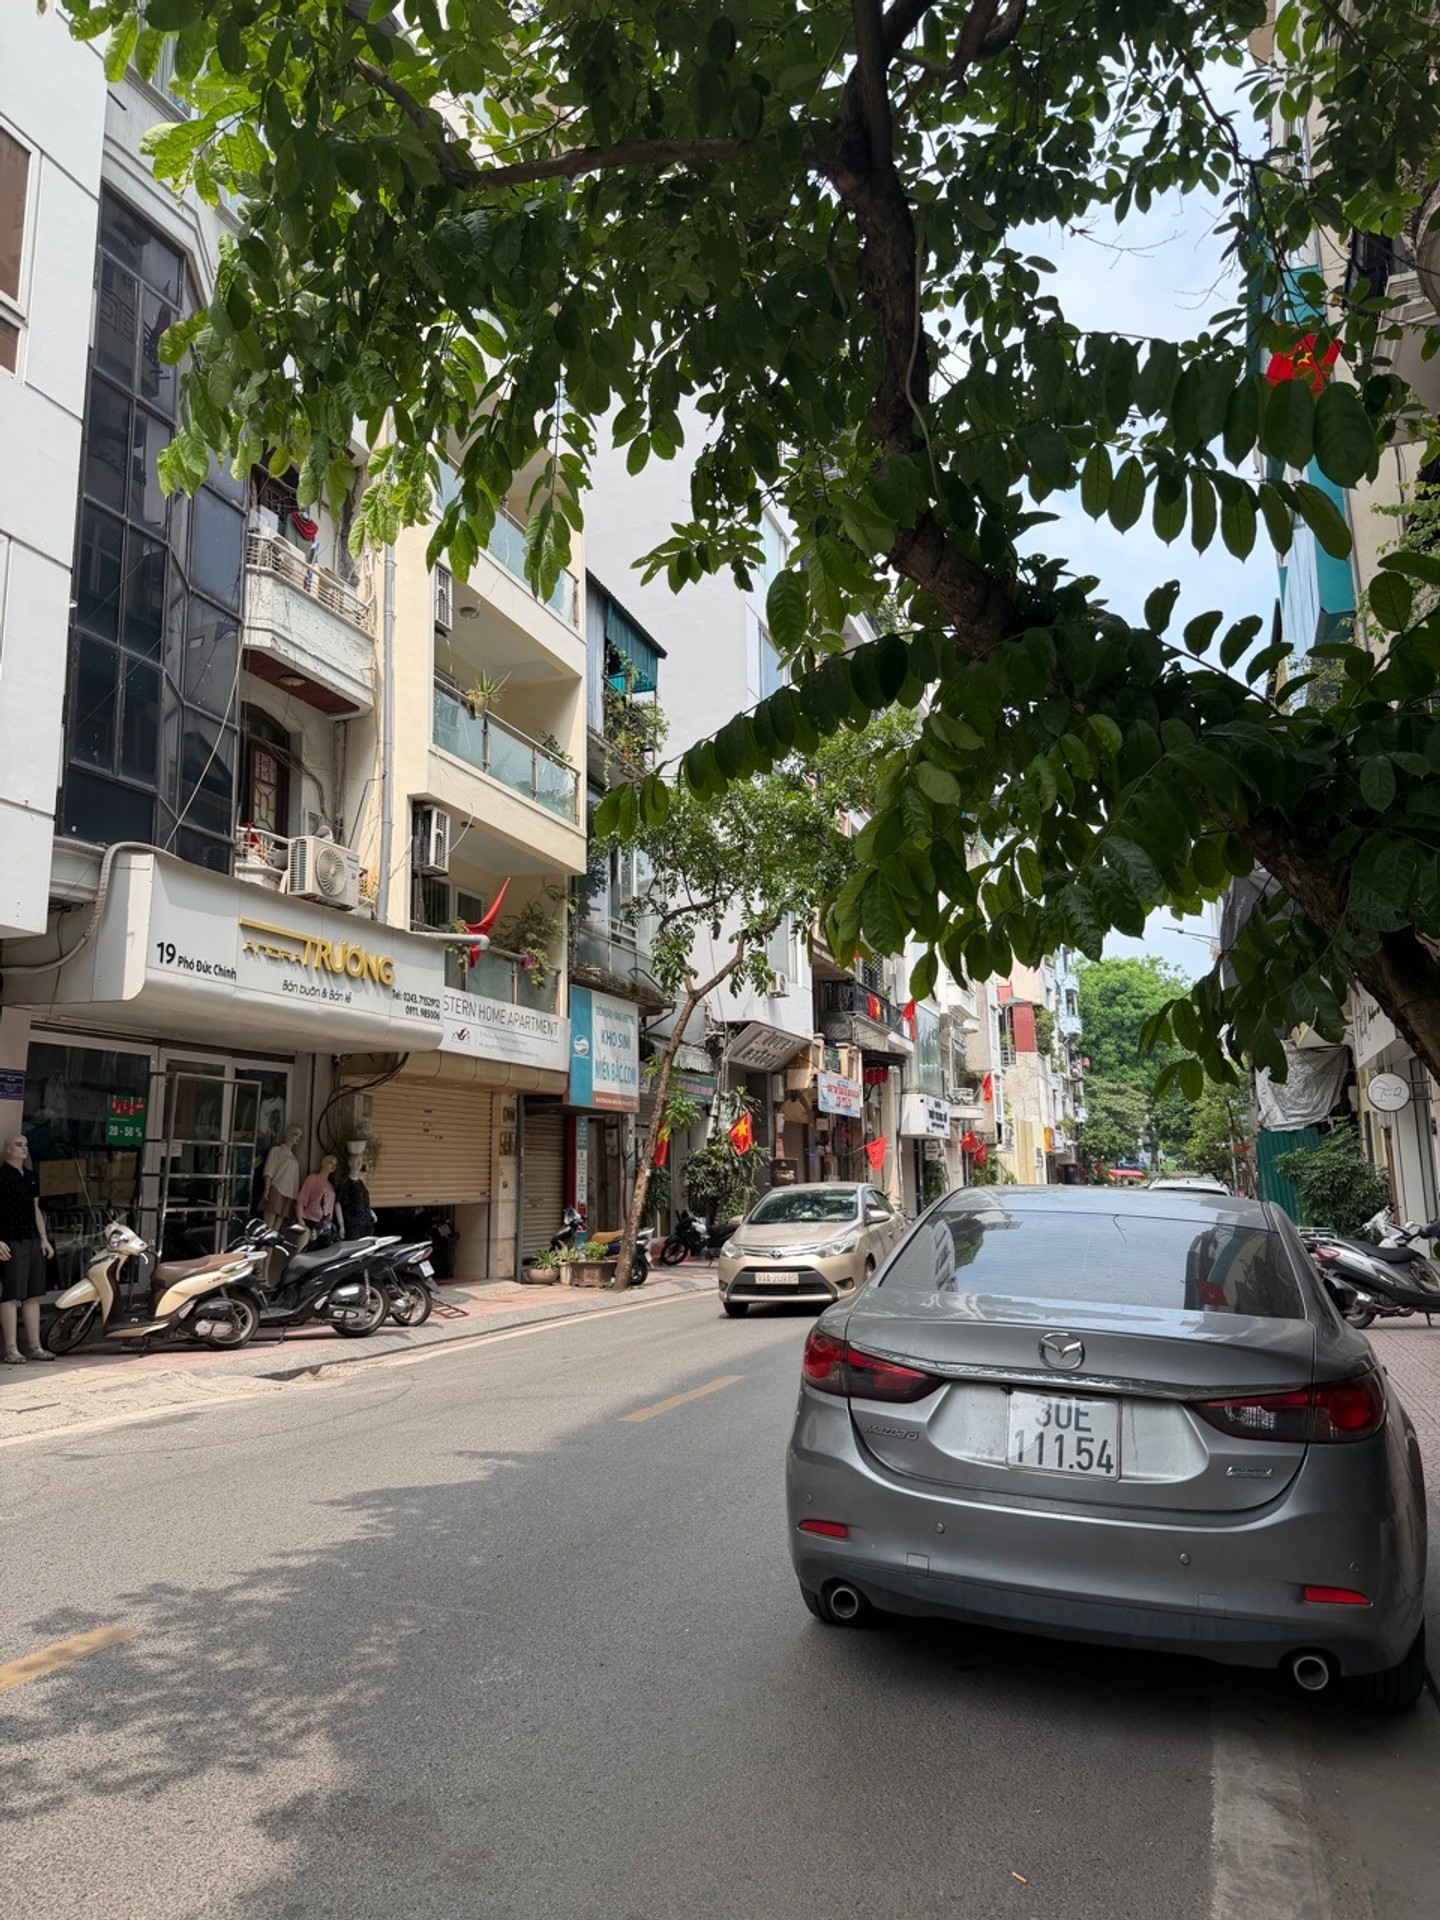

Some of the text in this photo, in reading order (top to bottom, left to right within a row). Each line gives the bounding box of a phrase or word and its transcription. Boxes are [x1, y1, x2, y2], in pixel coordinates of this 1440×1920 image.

[156, 942, 176, 964] 19
[213, 964, 237, 981] Chính
[321, 987, 328, 999] &
[478, 1003, 507, 1025] HOME
[507, 1011, 559, 1037] APARTMENT
[601, 1028, 632, 1051] KHO SIM
[109, 1125, 118, 1136] 20
[124, 1126, 134, 1137] 50
[1035, 1397, 1092, 1433] 30E
[1014, 1429, 1115, 1475] 111.54
